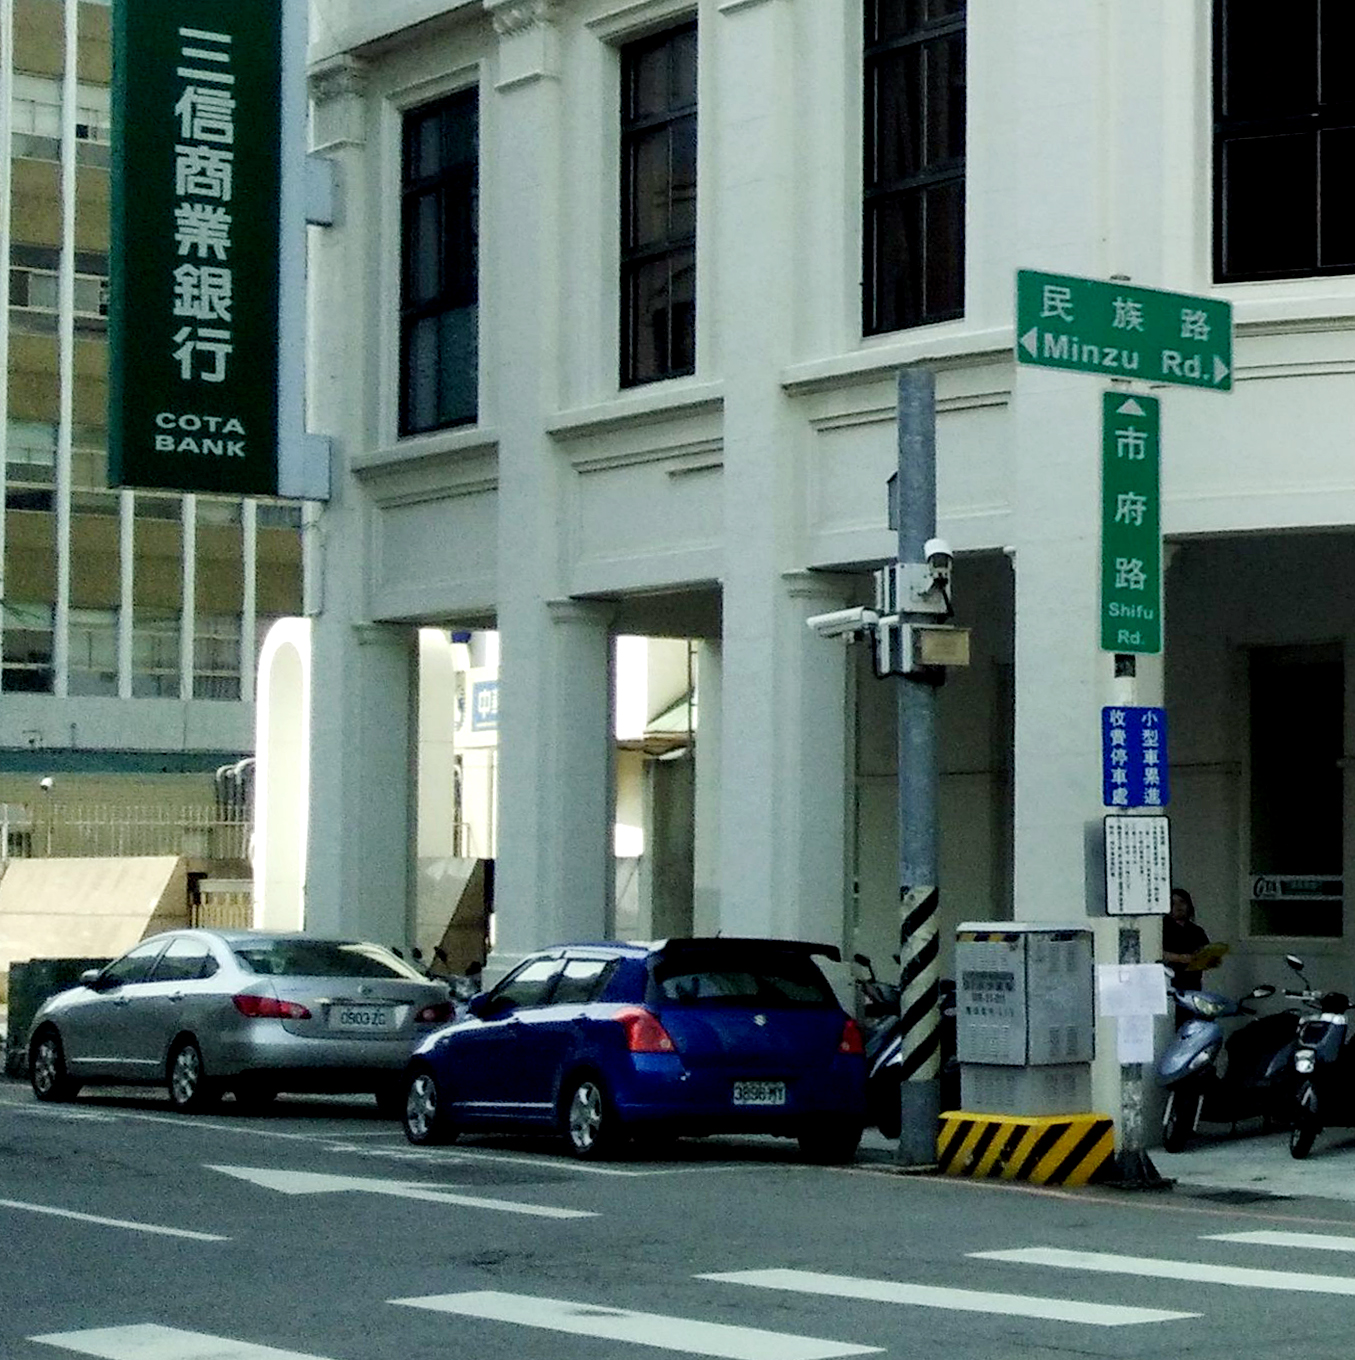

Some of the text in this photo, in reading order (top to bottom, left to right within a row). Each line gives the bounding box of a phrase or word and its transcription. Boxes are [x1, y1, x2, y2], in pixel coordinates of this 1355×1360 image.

[172, 26, 236, 383] 三信商業銀行
[1040, 285, 1211, 342] 民族路
[1043, 332, 1210, 380] Minzu Rd.
[155, 434, 246, 458] BANK
[156, 412, 246, 436] COTA
[1114, 426, 1148, 590] 市府路
[1108, 601, 1154, 620] Shifu
[1117, 628, 1146, 645] Rd.
[1109, 709, 1129, 805] 收費停車處
[1141, 710, 1161, 805] 小型車累進
